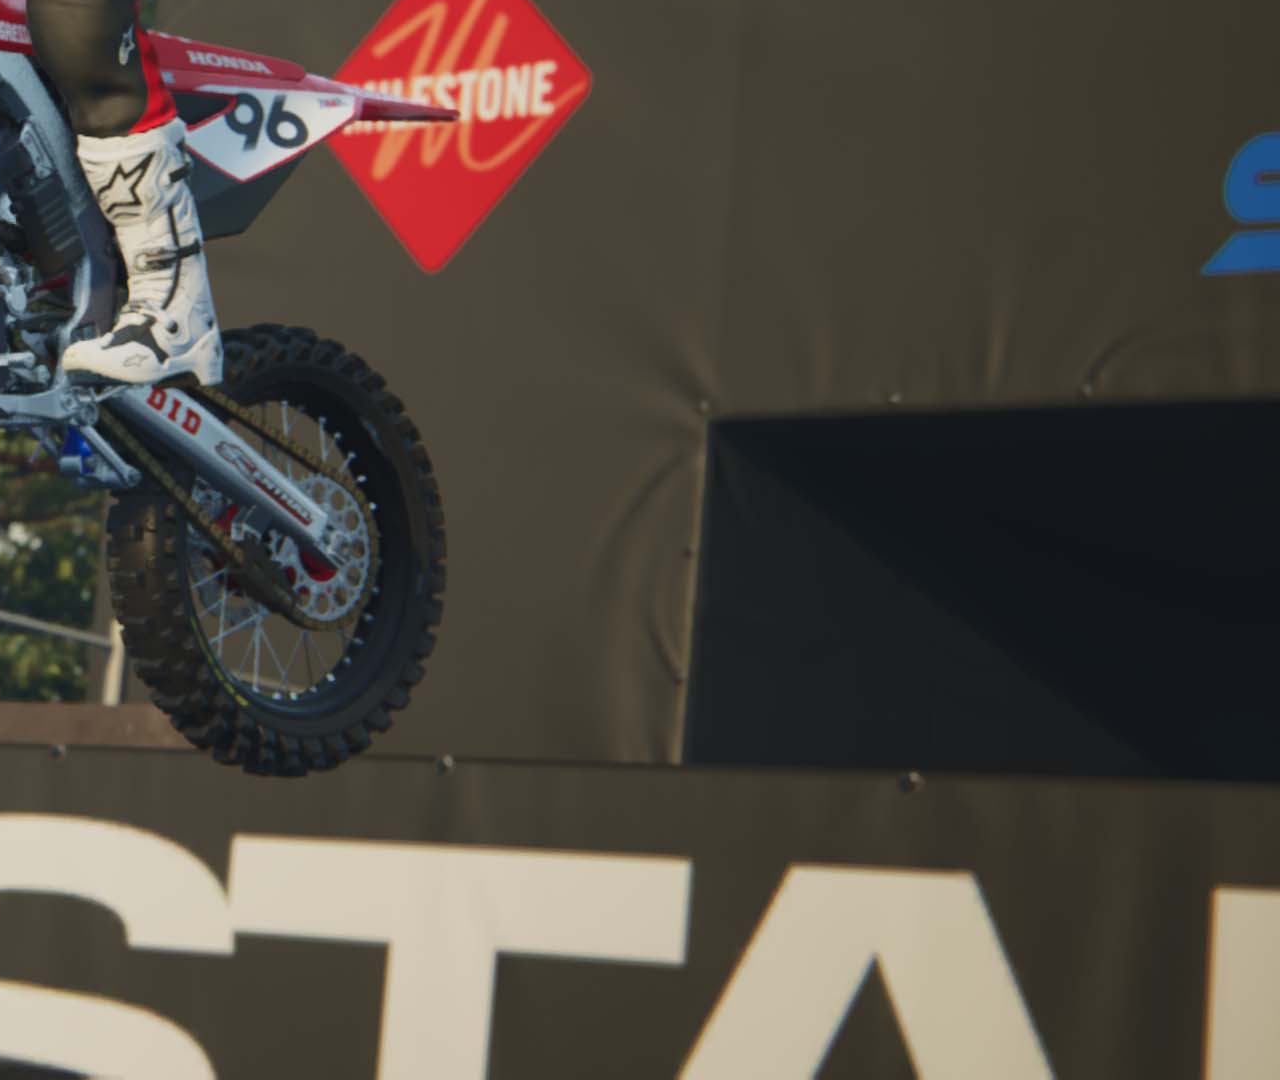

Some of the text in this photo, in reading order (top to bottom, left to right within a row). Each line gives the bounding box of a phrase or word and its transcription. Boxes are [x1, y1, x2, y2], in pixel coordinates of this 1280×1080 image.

[186, 50, 273, 75] HONDA
[225, 92, 309, 151] 96
[146, 385, 202, 436] DID
